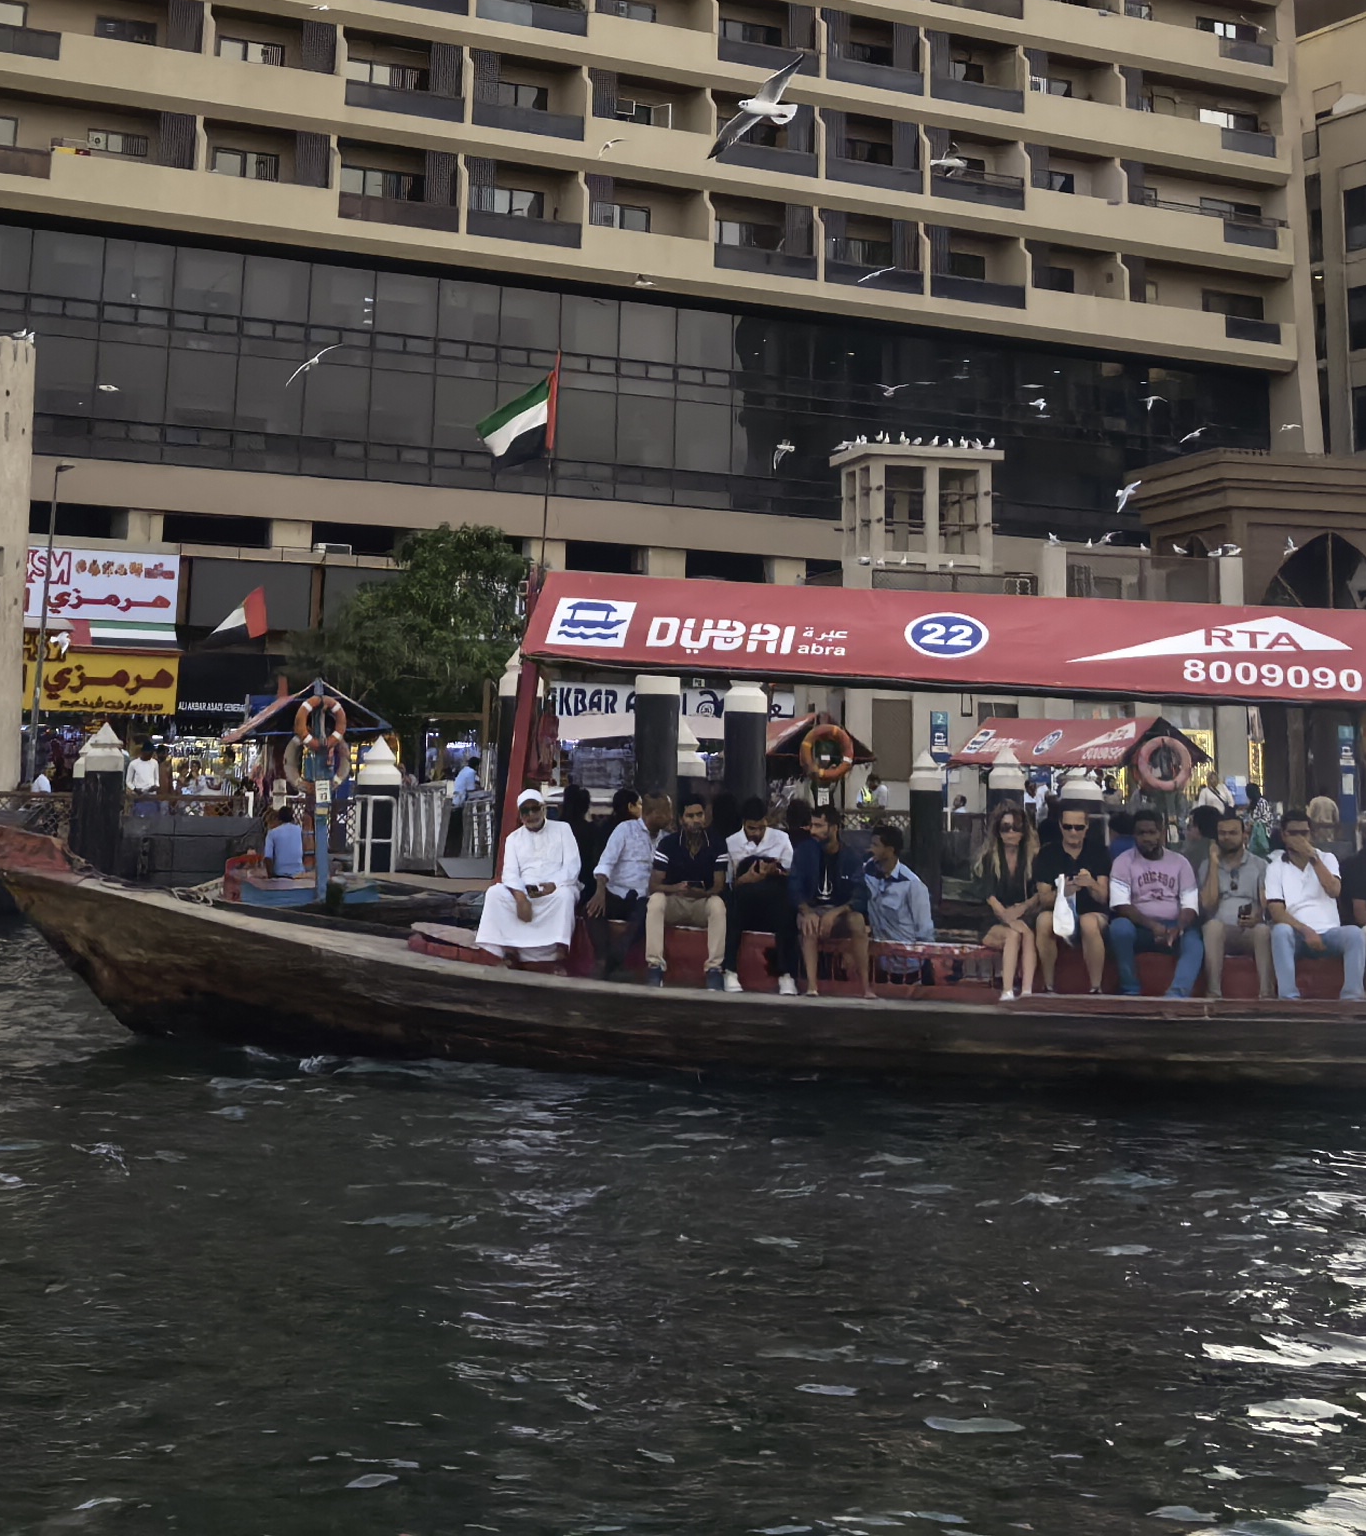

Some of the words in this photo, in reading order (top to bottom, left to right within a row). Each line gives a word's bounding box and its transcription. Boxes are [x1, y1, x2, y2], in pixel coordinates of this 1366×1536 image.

[646, 616, 796, 654] DUBAI
[797, 643, 845, 656] abra
[919, 623, 973, 646] 22
[803, 627, 848, 642] عبرة
[1203, 628, 1304, 651] RTA
[43, 664, 175, 700] هرمزي
[1183, 659, 1363, 692] 8009090
